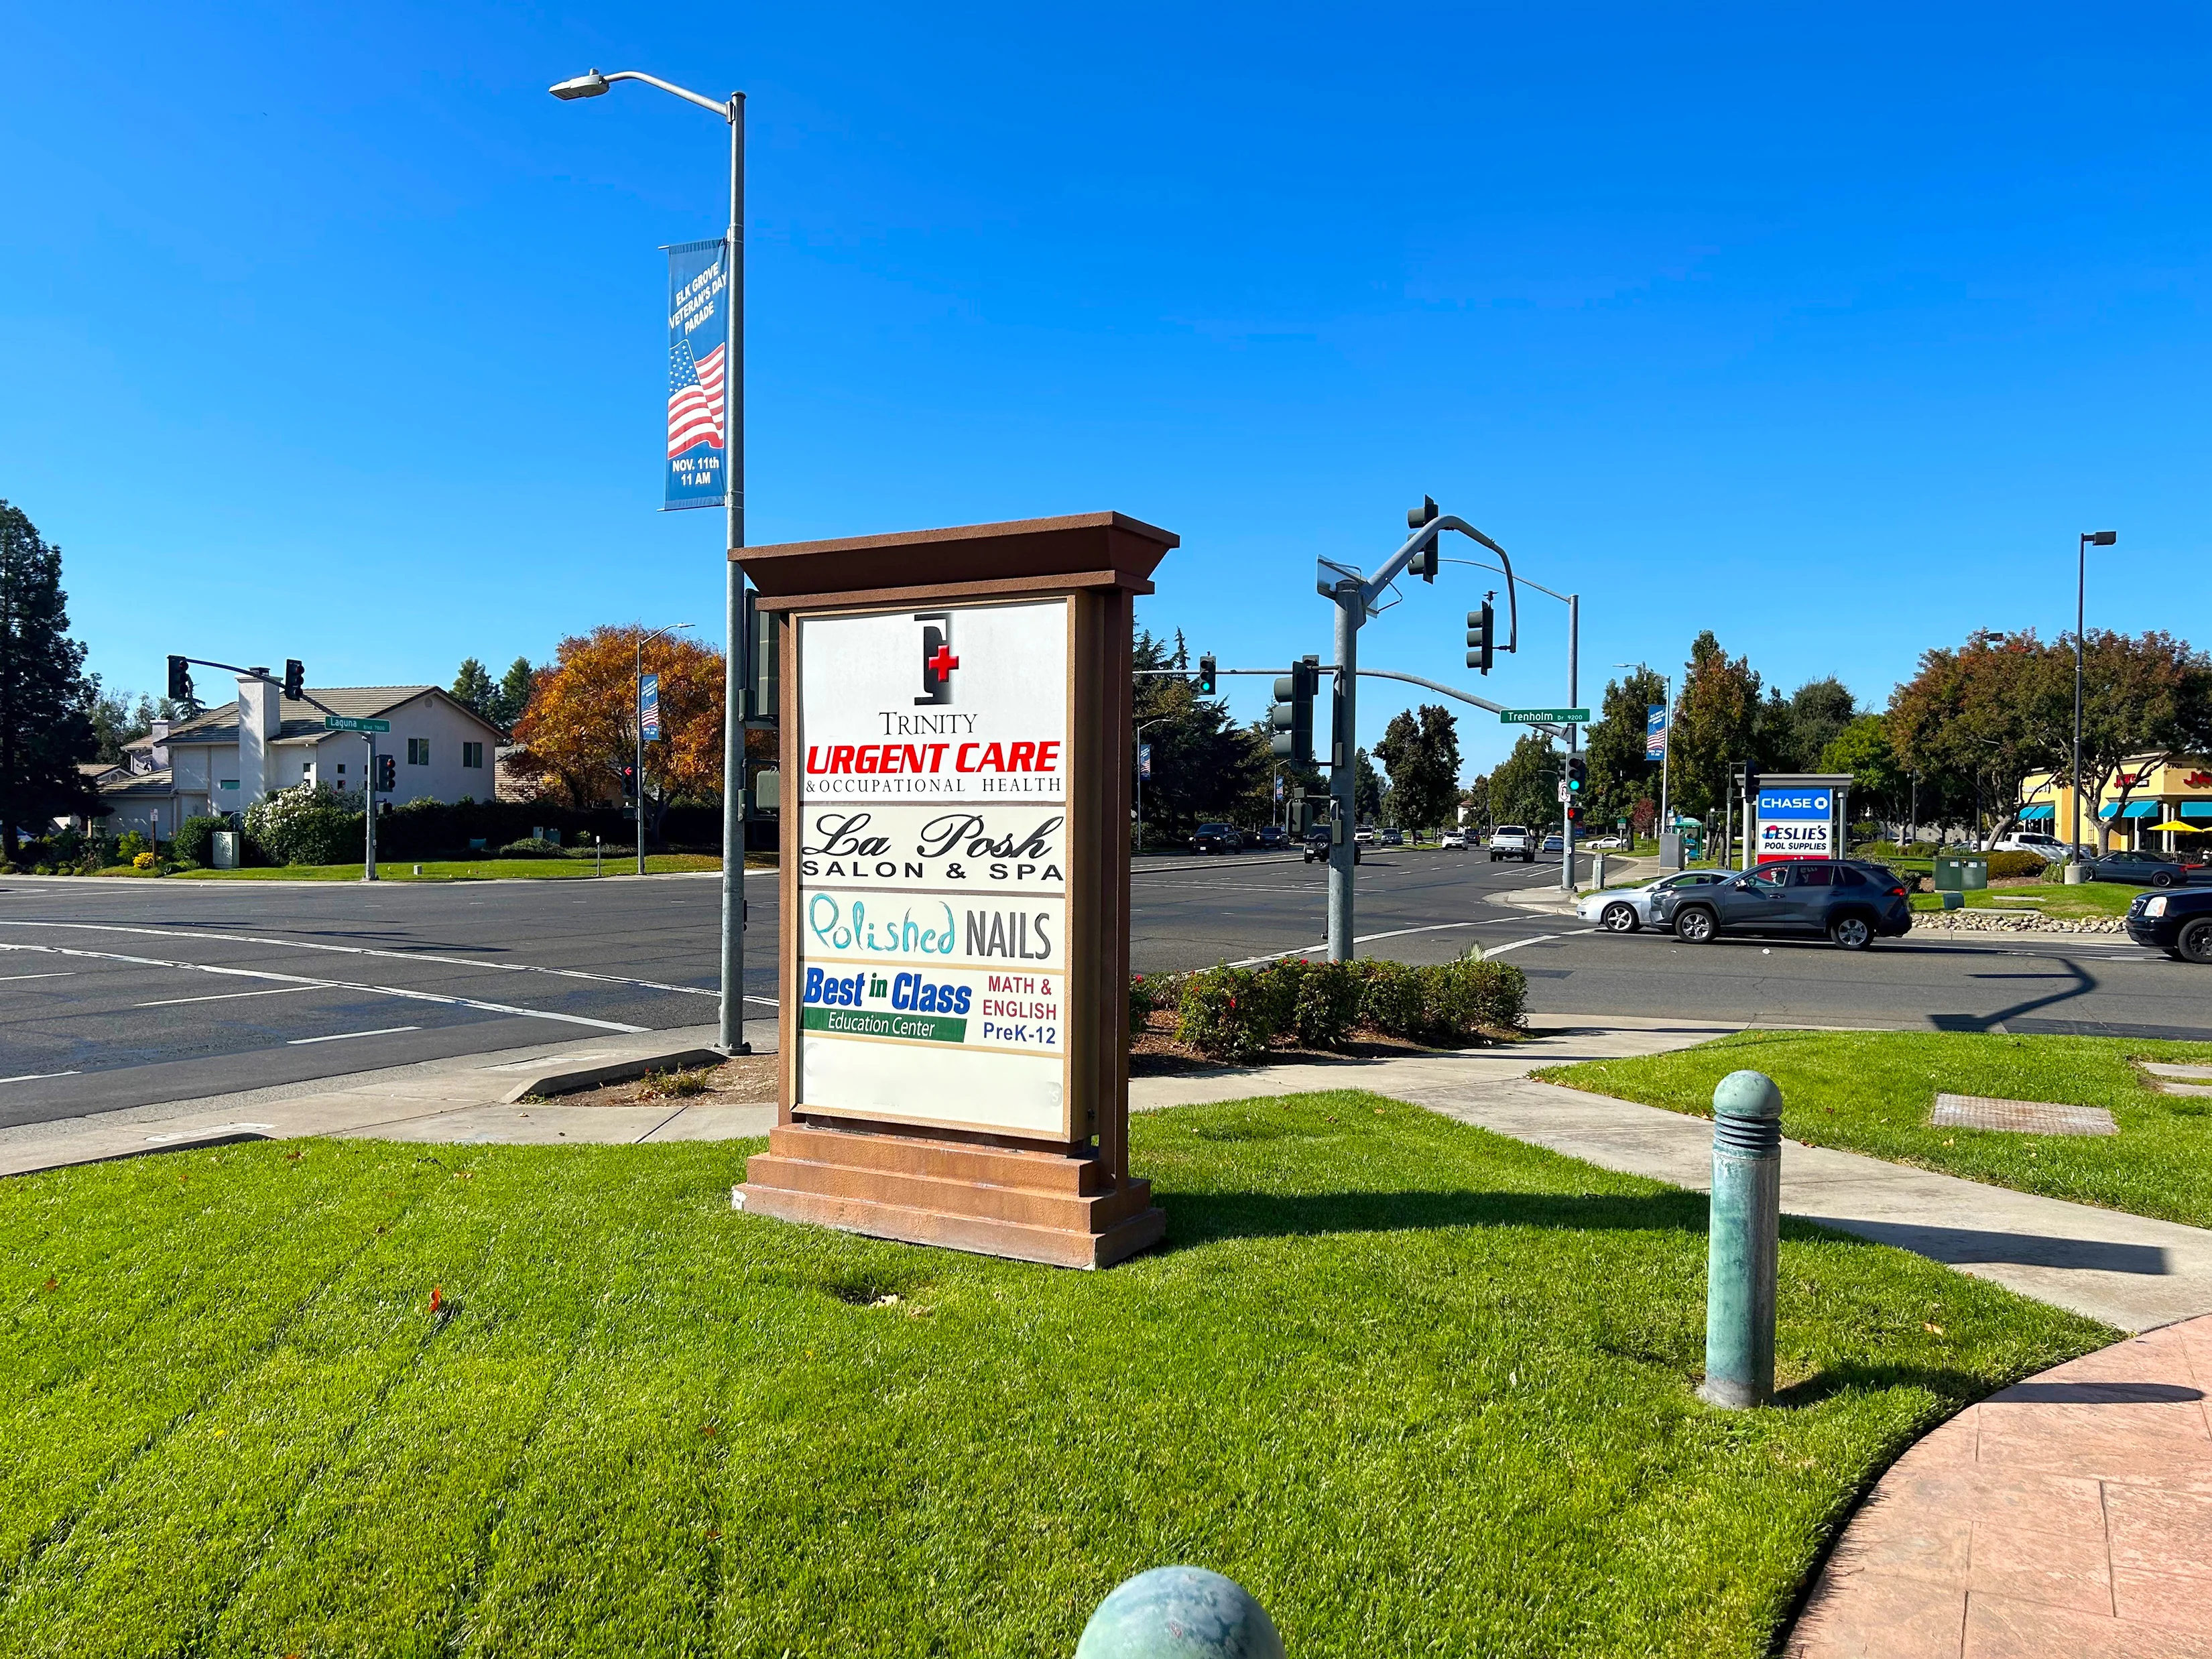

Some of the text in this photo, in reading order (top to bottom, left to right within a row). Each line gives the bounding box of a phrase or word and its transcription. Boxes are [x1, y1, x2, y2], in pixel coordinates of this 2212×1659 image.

[676, 261, 719, 308] ELK GROVE
[669, 271, 727, 330] VETERAN'S DAY
[684, 304, 714, 336] PARADE
[672, 456, 719, 472] NOV. 11th
[681, 471, 711, 485] 11 AM
[330, 717, 357, 729] Laguna
[1508, 711, 1553, 721] Trenholm
[806, 741, 1061, 774] URGENT CARE
[806, 778, 1061, 793] & OCCUPATIONAL HEALTH
[1761, 798, 1812, 808] CHASE
[802, 813, 1064, 859] La Posh
[1762, 825, 1827, 840] LESLIE'S
[802, 861, 1064, 881] SALON & SPA
[809, 893, 1051, 960] Polished NAILS
[803, 967, 973, 1015] Best in Class
[988, 975, 1052, 996] MATH &
[983, 999, 1057, 1021] ENGLISH
[828, 1011, 936, 1038] Education Center
[983, 1022, 1056, 1045] PreK-12
